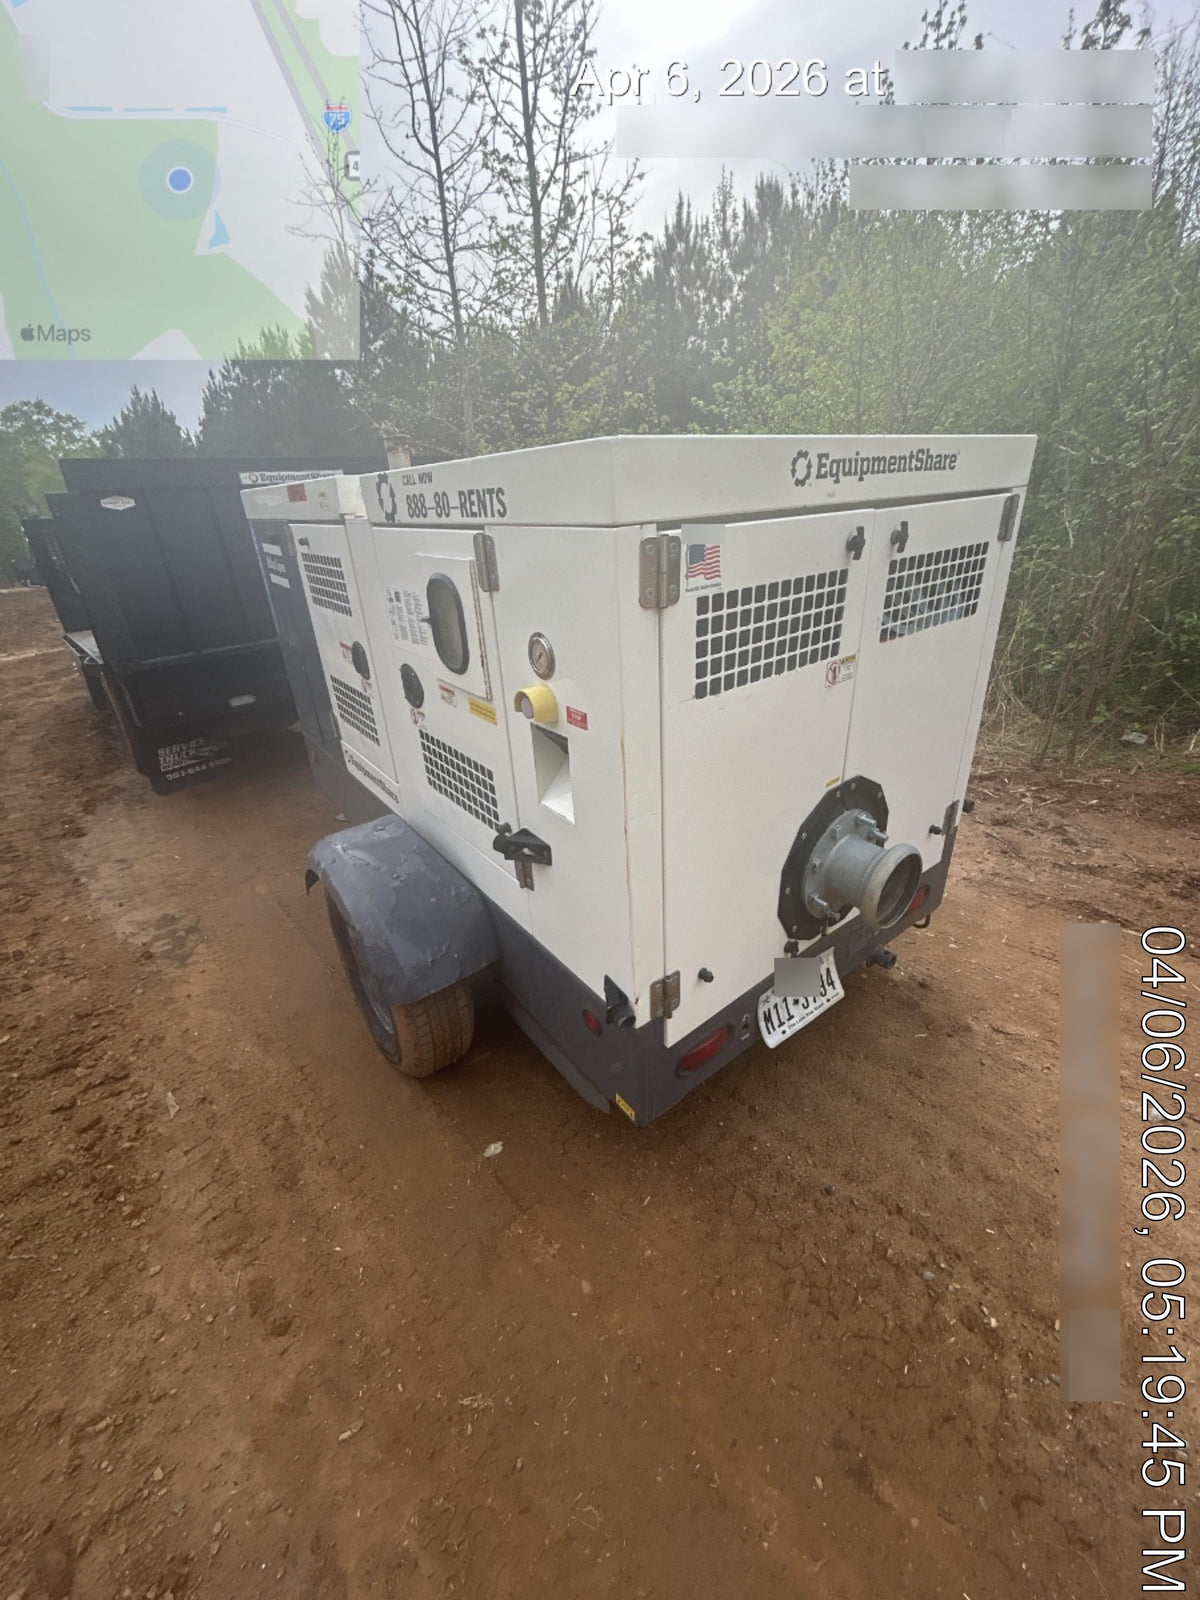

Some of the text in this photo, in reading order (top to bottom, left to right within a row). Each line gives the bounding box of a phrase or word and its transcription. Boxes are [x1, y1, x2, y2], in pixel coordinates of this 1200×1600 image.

[402, 471, 432, 487] CALL NOW
[815, 447, 957, 483] EquipmentShare
[406, 486, 508, 519] 888-80-RENTS
